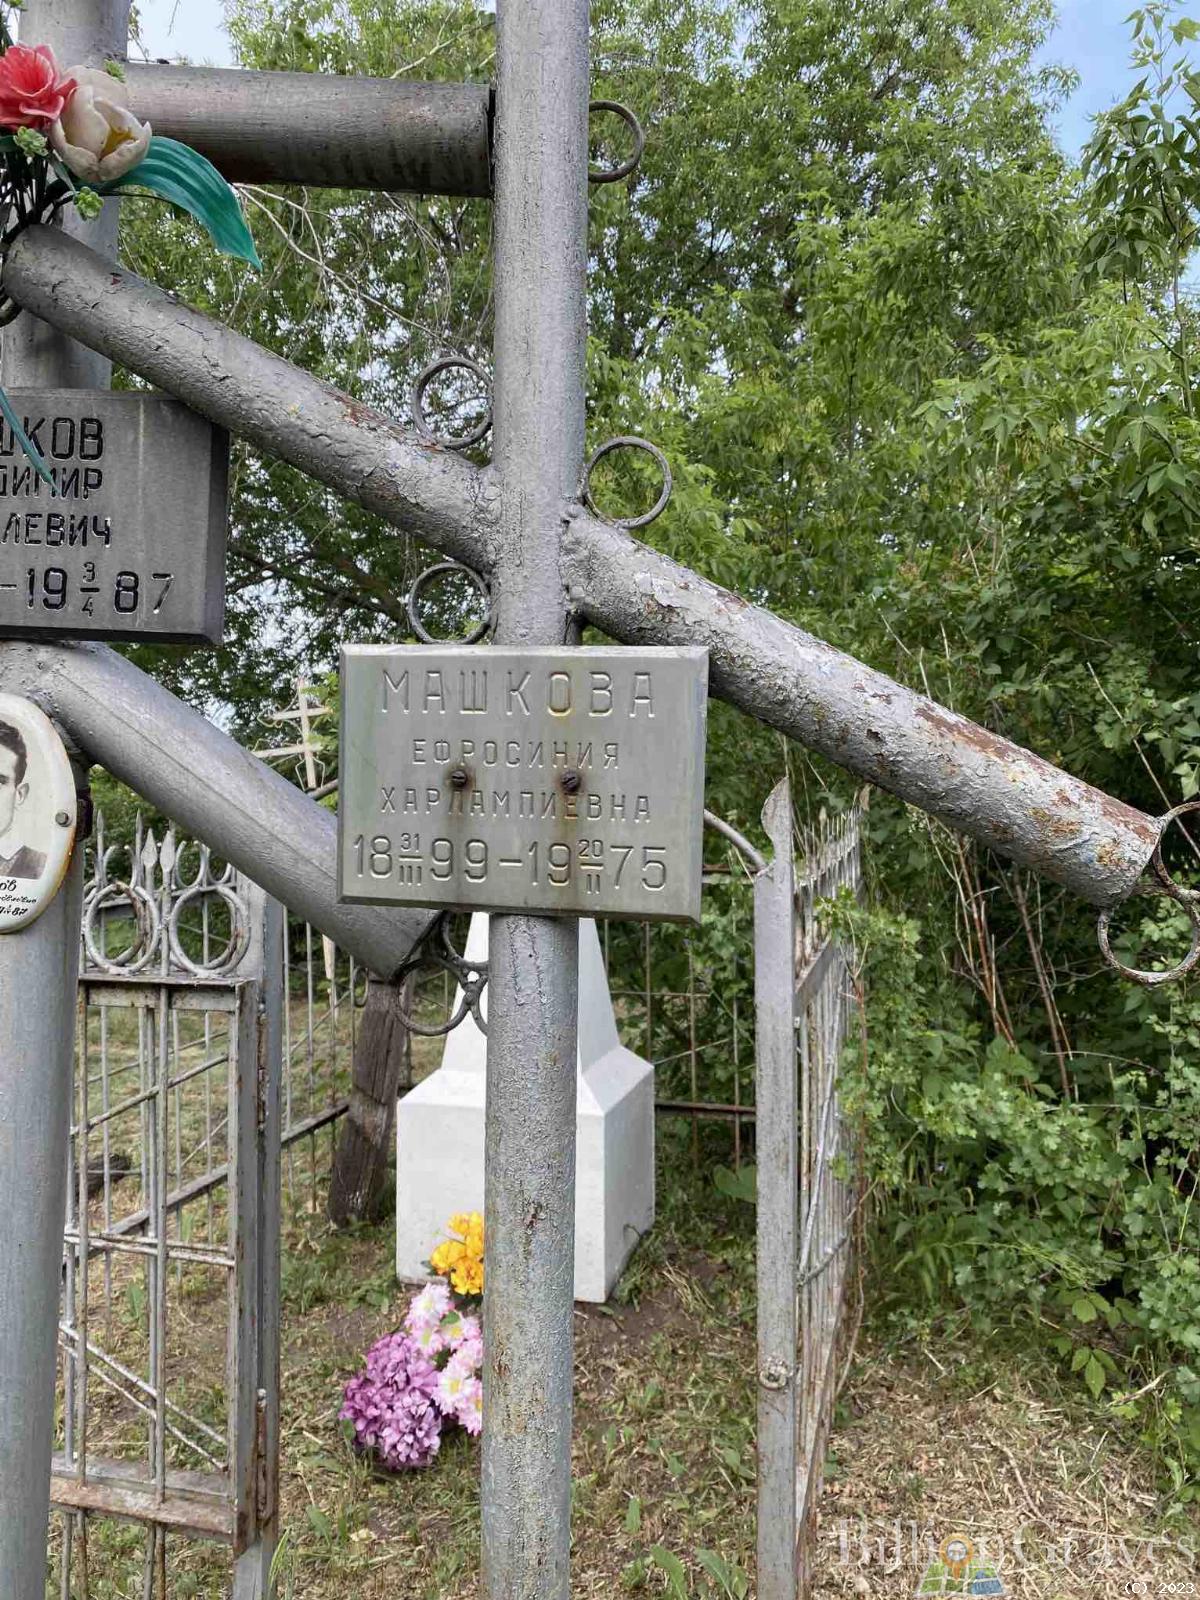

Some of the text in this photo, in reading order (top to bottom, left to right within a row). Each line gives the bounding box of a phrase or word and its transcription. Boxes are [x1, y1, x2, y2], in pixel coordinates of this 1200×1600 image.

[1, 512, 111, 547] ЛЕВИЧ
[114, 570, 174, 614] 87
[381, 670, 655, 718] МАШКОВА
[412, 739, 619, 769] ЕФРОСИНИЯ
[381, 787, 651, 823] ХАРЛАМПИЕВНА
